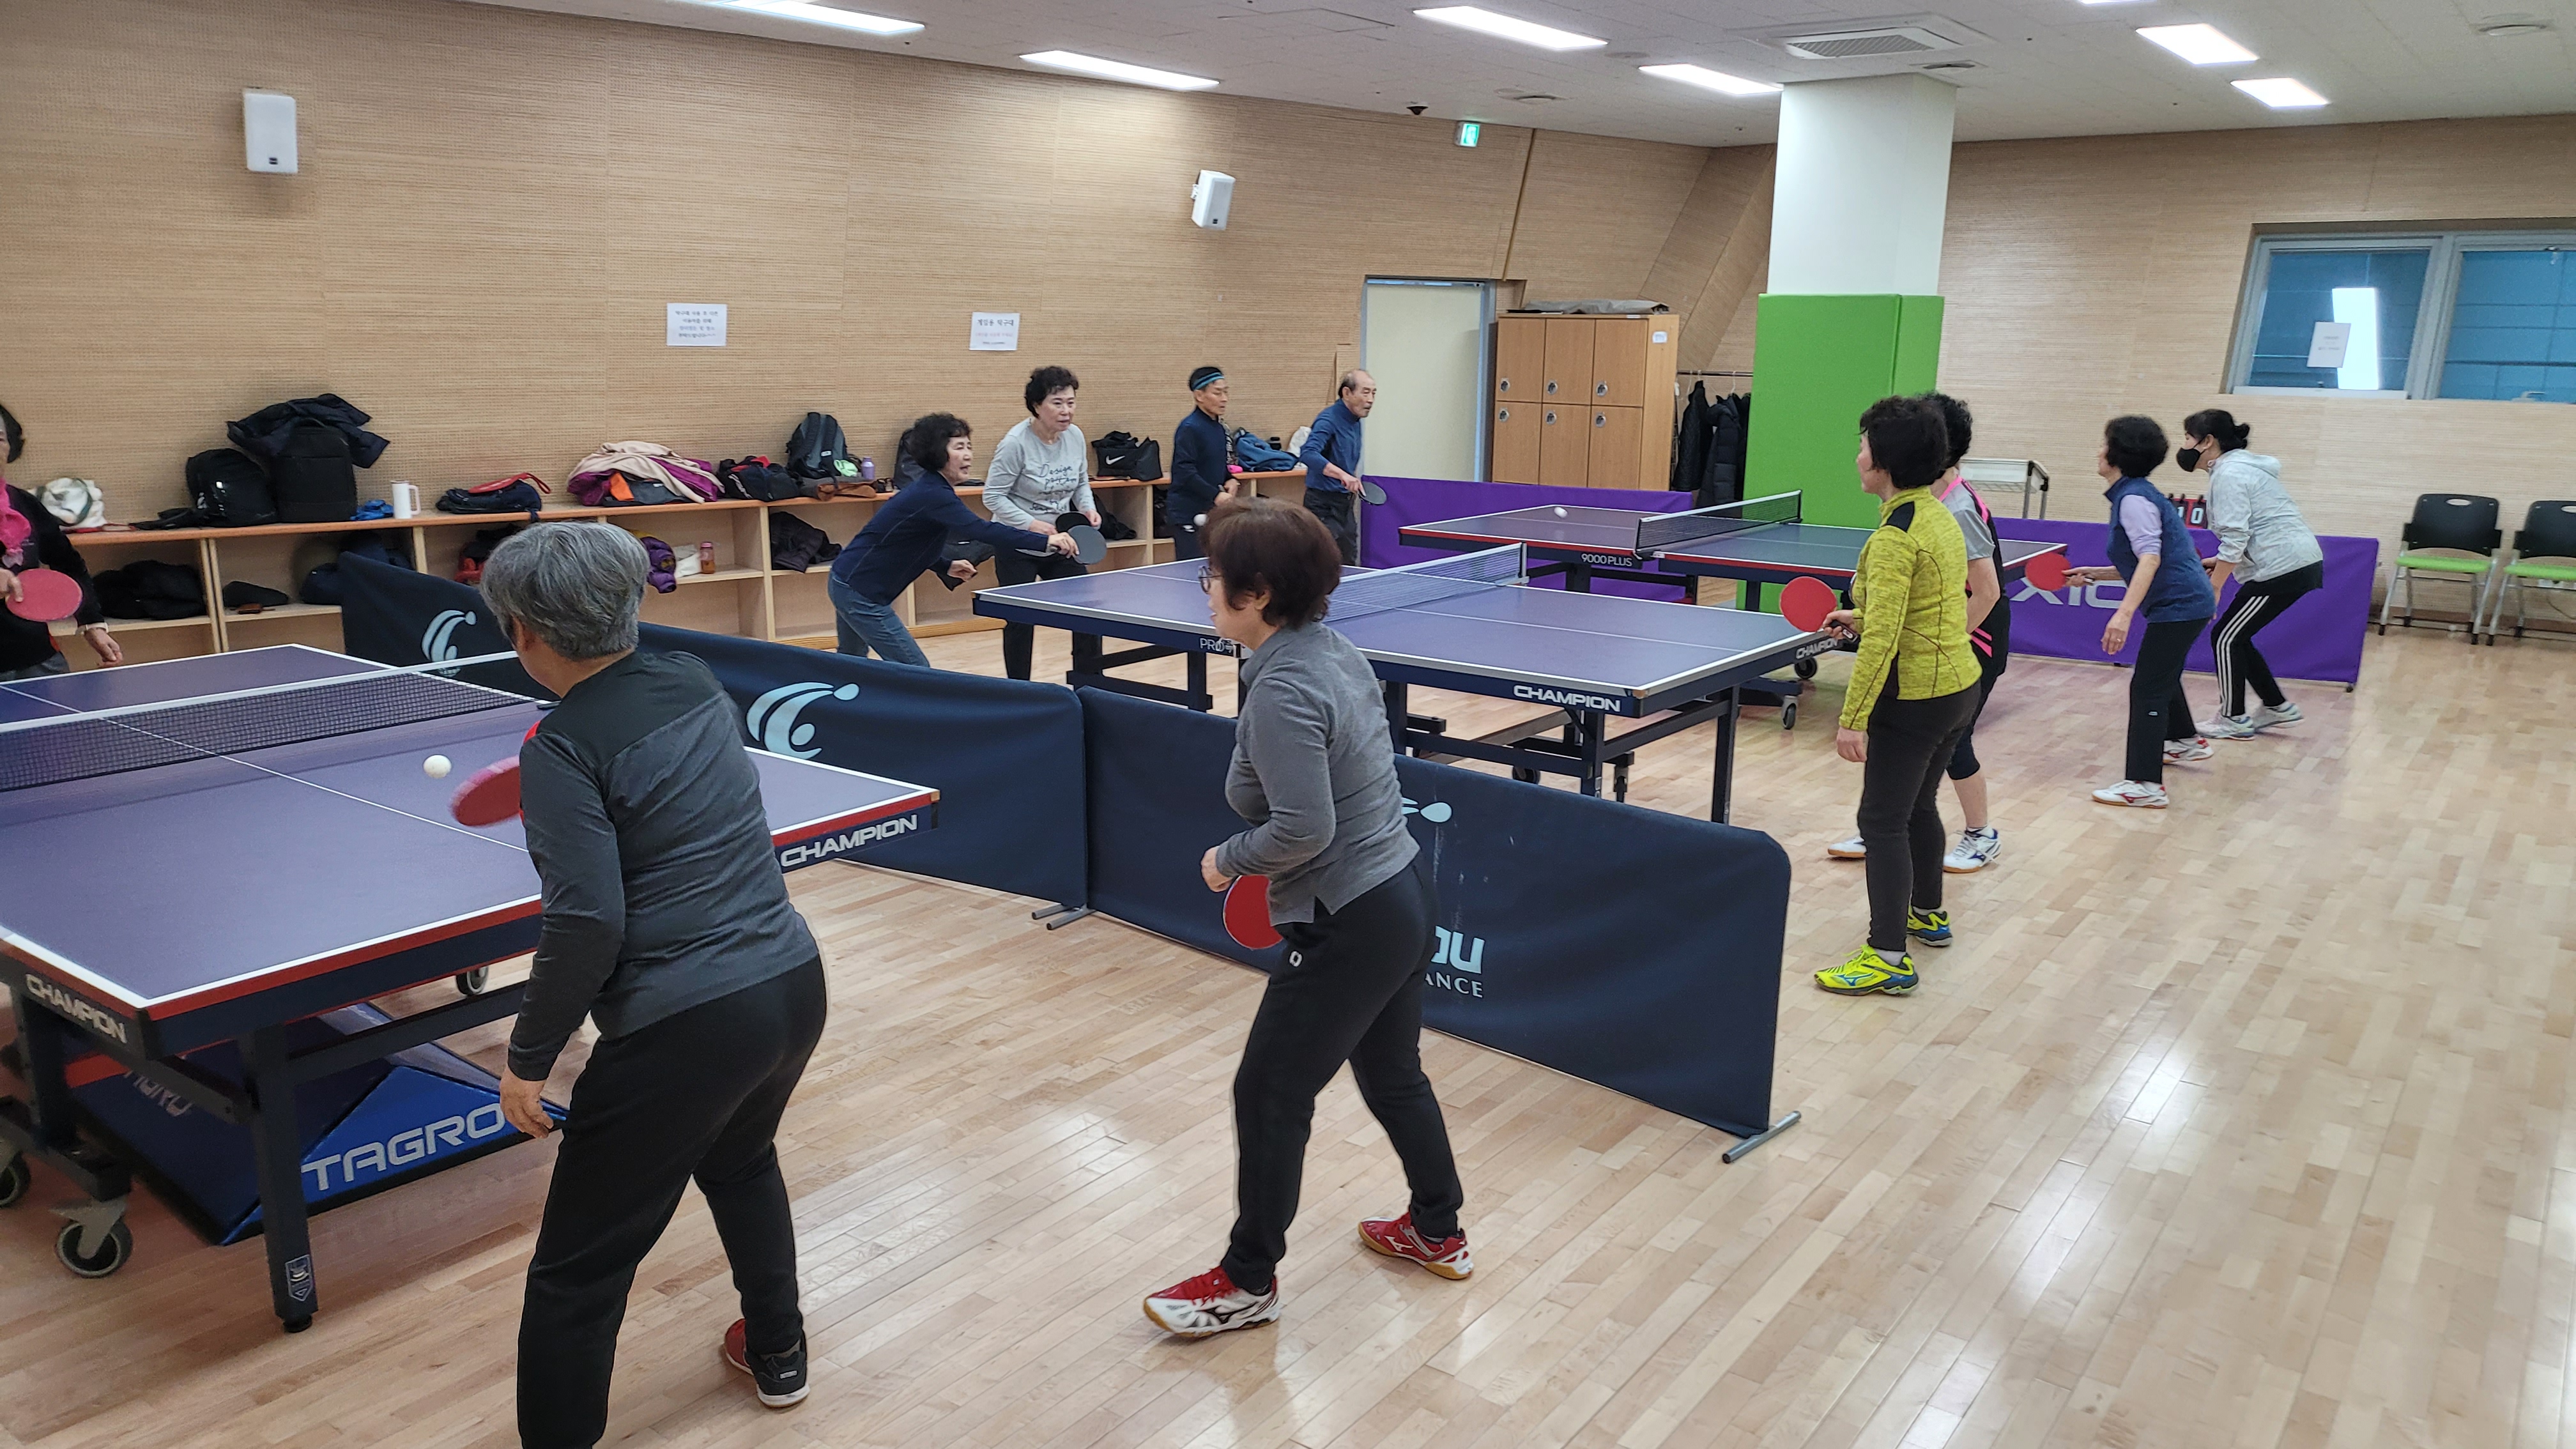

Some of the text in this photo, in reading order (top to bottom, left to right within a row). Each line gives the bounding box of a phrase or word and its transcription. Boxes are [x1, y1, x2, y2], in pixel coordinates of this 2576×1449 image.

[1514, 685, 1620, 712] CHAMPION
[780, 814, 917, 867] CHAMPION
[26, 974, 127, 1044] CHAMPION
[301, 1103, 507, 1192] TAGRO
